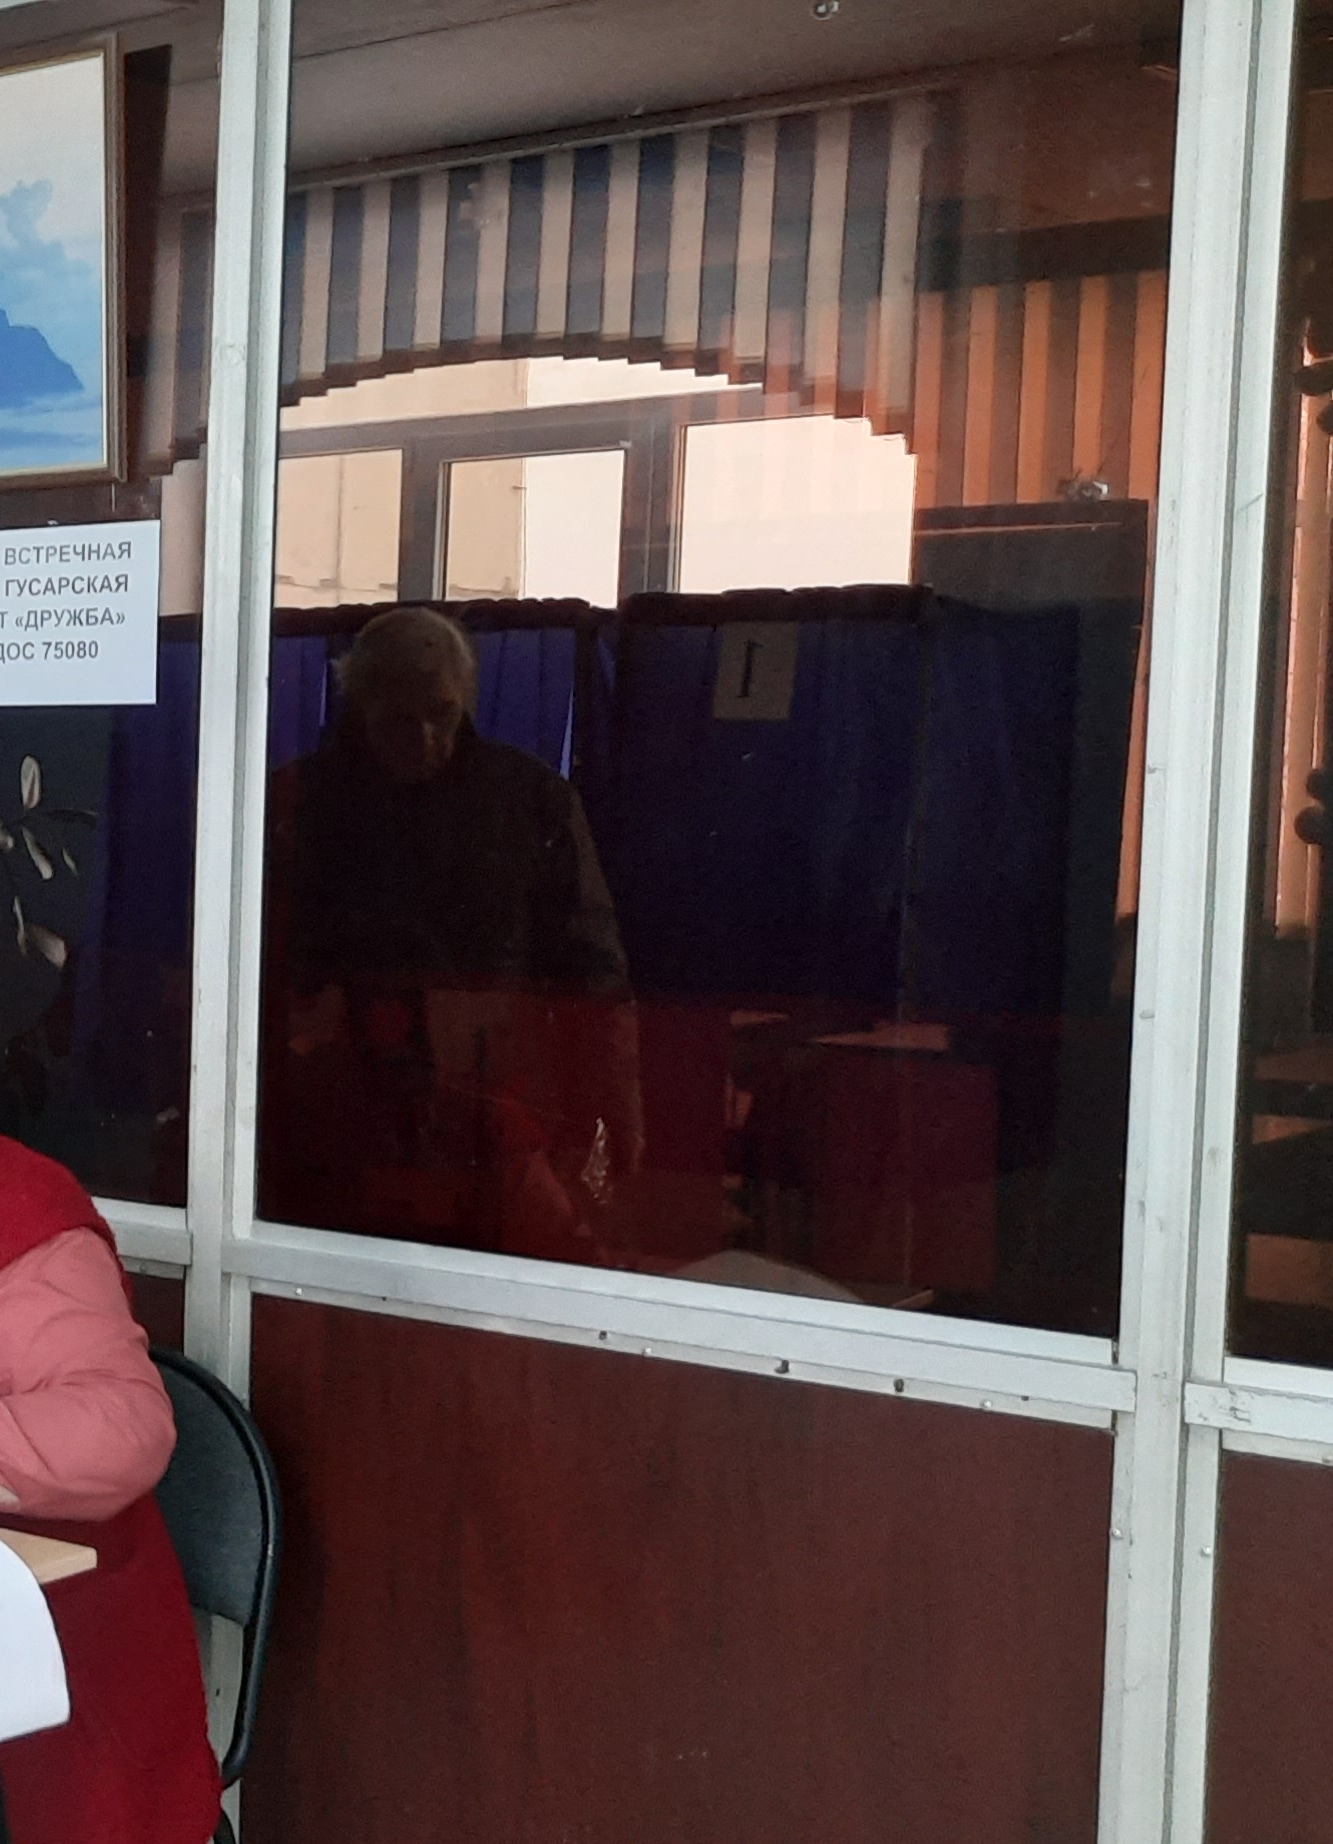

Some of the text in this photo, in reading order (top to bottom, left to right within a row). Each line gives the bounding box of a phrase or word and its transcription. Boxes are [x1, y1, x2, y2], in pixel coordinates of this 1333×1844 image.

[4, 541, 132, 566] ВСТРЕЧНАЯ
[4, 573, 129, 597] ГУСАРСКАЯ
[14, 606, 126, 632] «ДРУЖБА»
[41, 639, 99, 660] 75080
